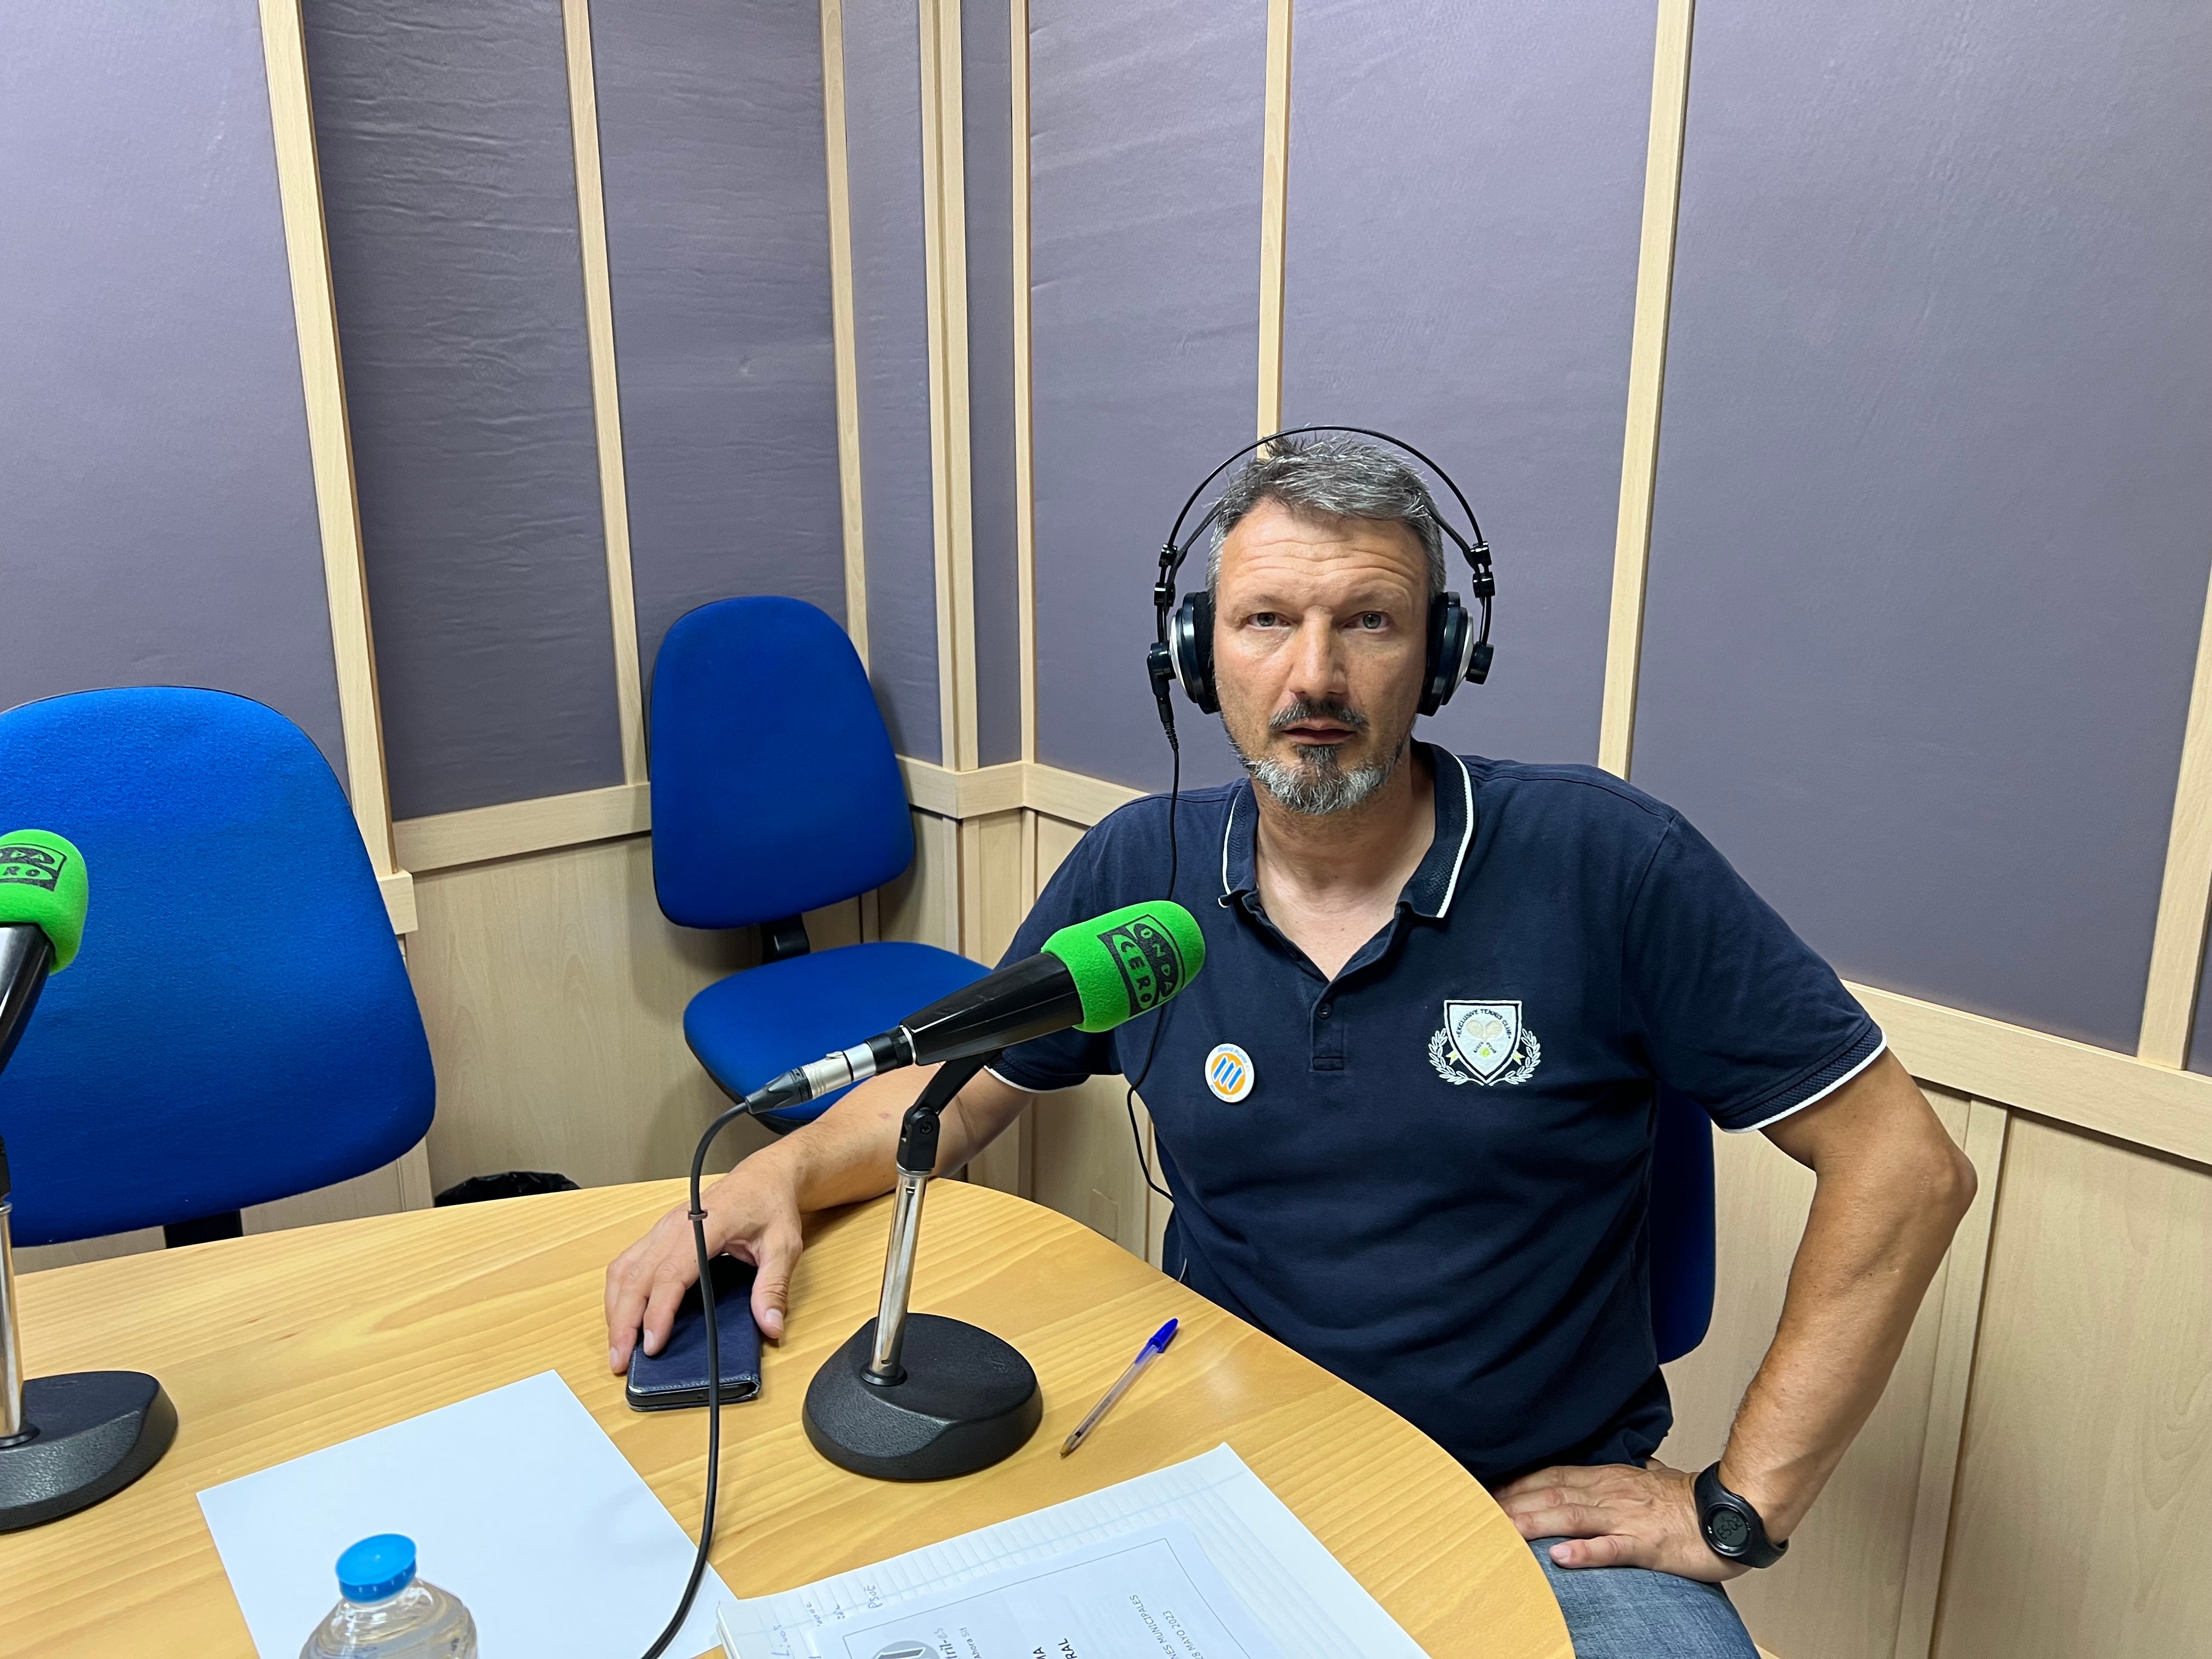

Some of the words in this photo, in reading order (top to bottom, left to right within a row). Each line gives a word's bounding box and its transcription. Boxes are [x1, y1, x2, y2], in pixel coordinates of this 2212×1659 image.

[0, 850, 45, 862] DA
[1120, 940, 1152, 1003] CERO
[1141, 928, 1173, 994] ONDA
[1456, 1009, 1479, 1035] EXCLUSIVE
[1480, 1009, 1503, 1020] TENNIS
[1502, 1020, 1512, 1035] CLUB
[1130, 1595, 1167, 1643] MUNICIPALES
[1163, 1611, 1180, 1628] 2023
[967, 1639, 982, 1659] Ahora
[1176, 1630, 1196, 1650] MAYO
